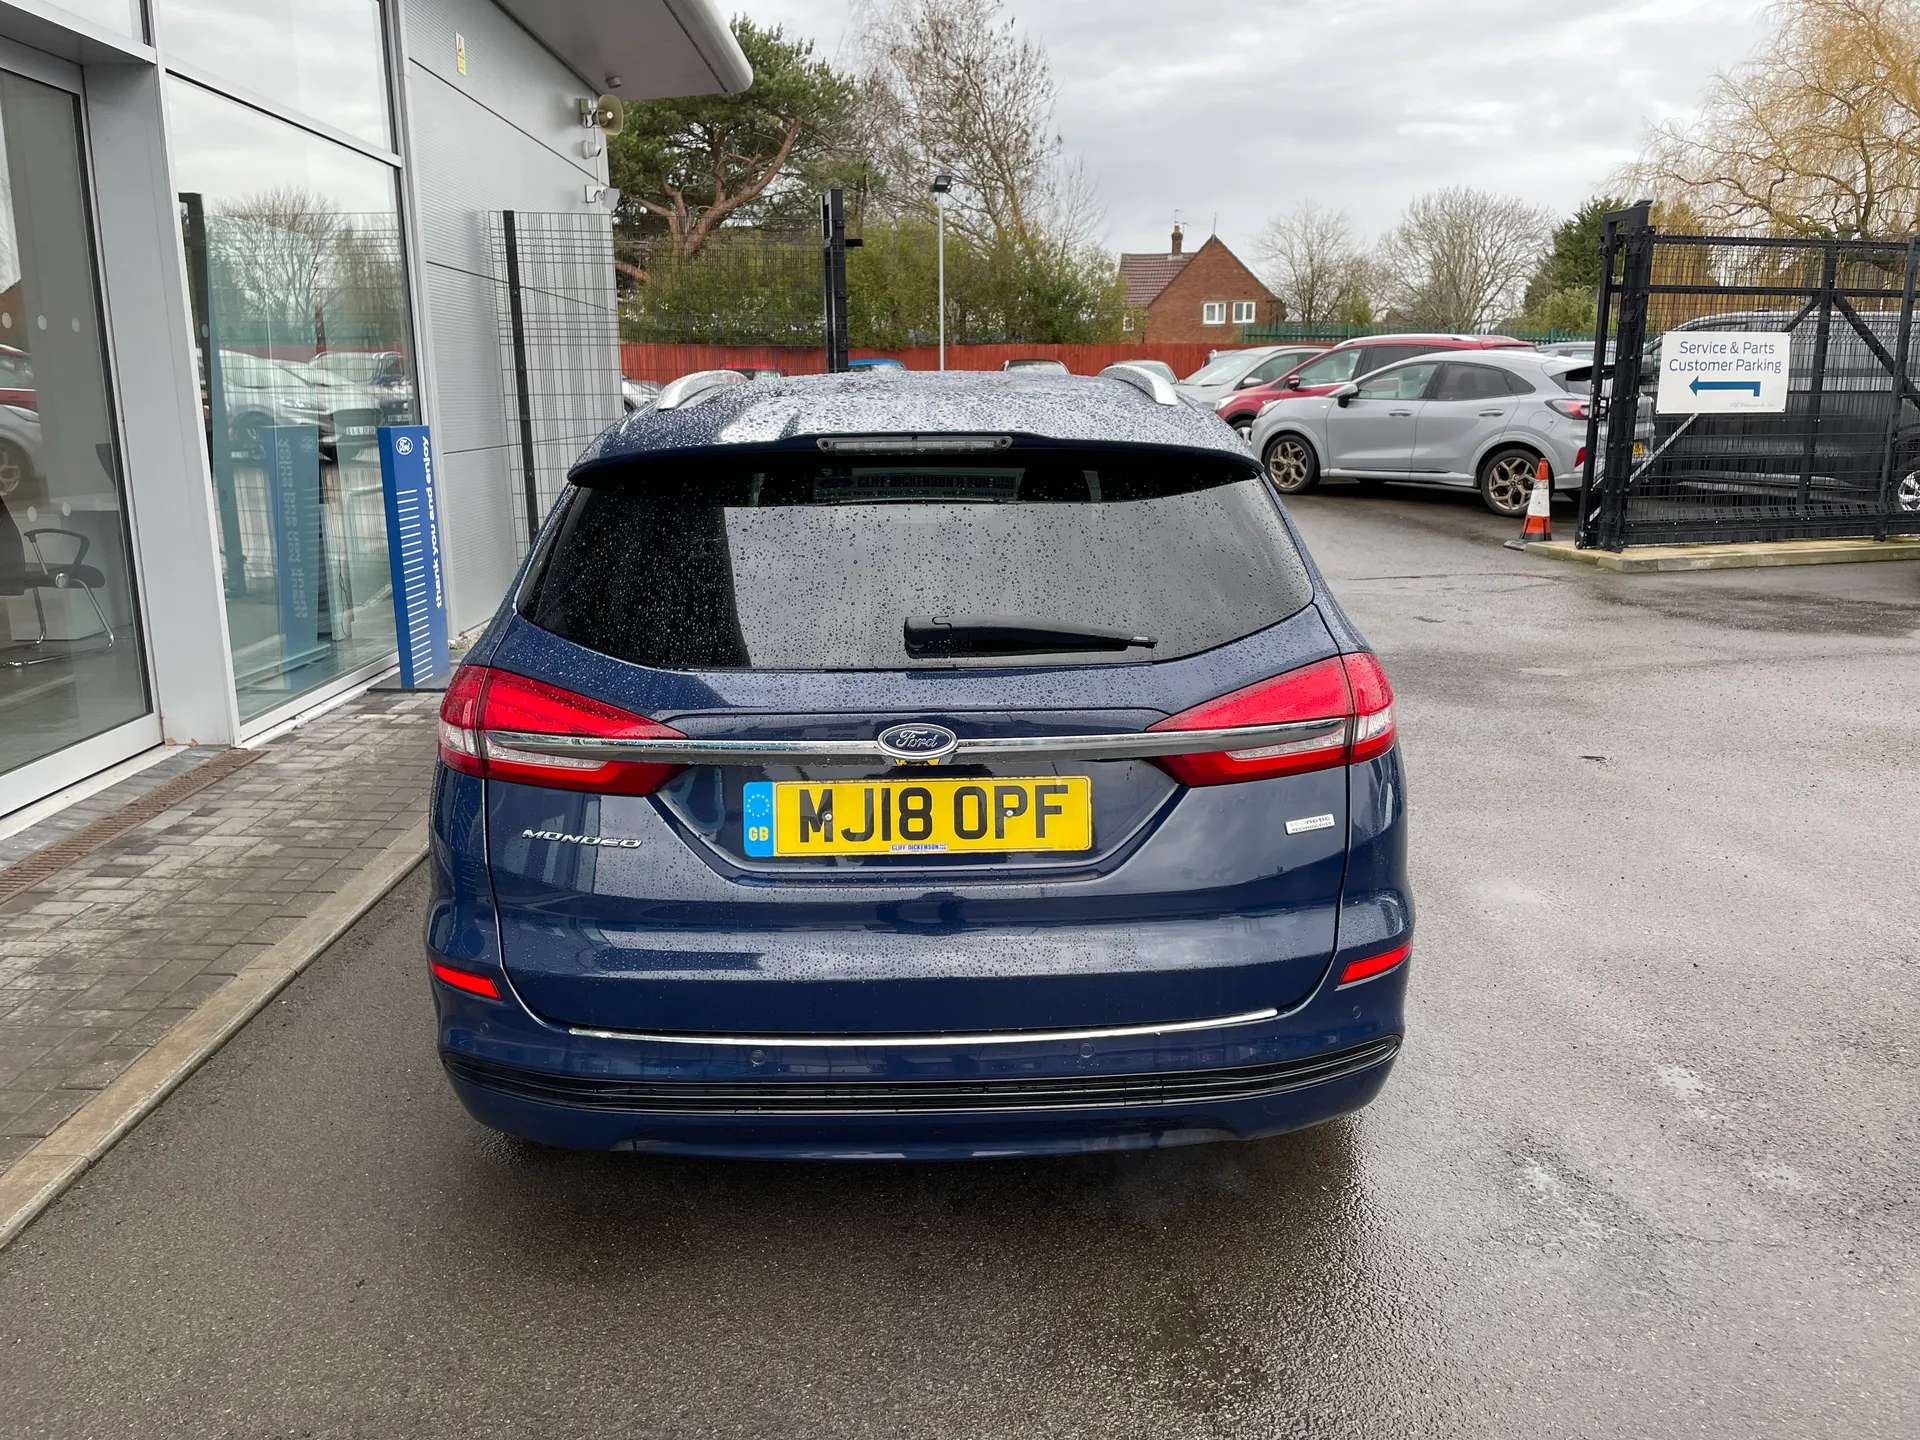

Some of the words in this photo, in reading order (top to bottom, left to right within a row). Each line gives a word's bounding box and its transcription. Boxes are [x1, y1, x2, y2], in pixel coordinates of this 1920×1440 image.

[1680, 341, 1726, 354] Service
[1730, 341, 1739, 354] &
[1743, 341, 1775, 354] Parts
[1669, 359, 1733, 372] Customer
[1736, 359, 1782, 374] Parking
[422, 436, 431, 484] enjoy
[426, 487, 435, 520] and
[431, 524, 439, 556] you
[433, 558, 442, 608] thank
[896, 729, 939, 748] Ford
[799, 786, 933, 843] MJ18
[953, 784, 1069, 841] OPF
[522, 829, 642, 848] MONDEO
[749, 826, 768, 841] GB
